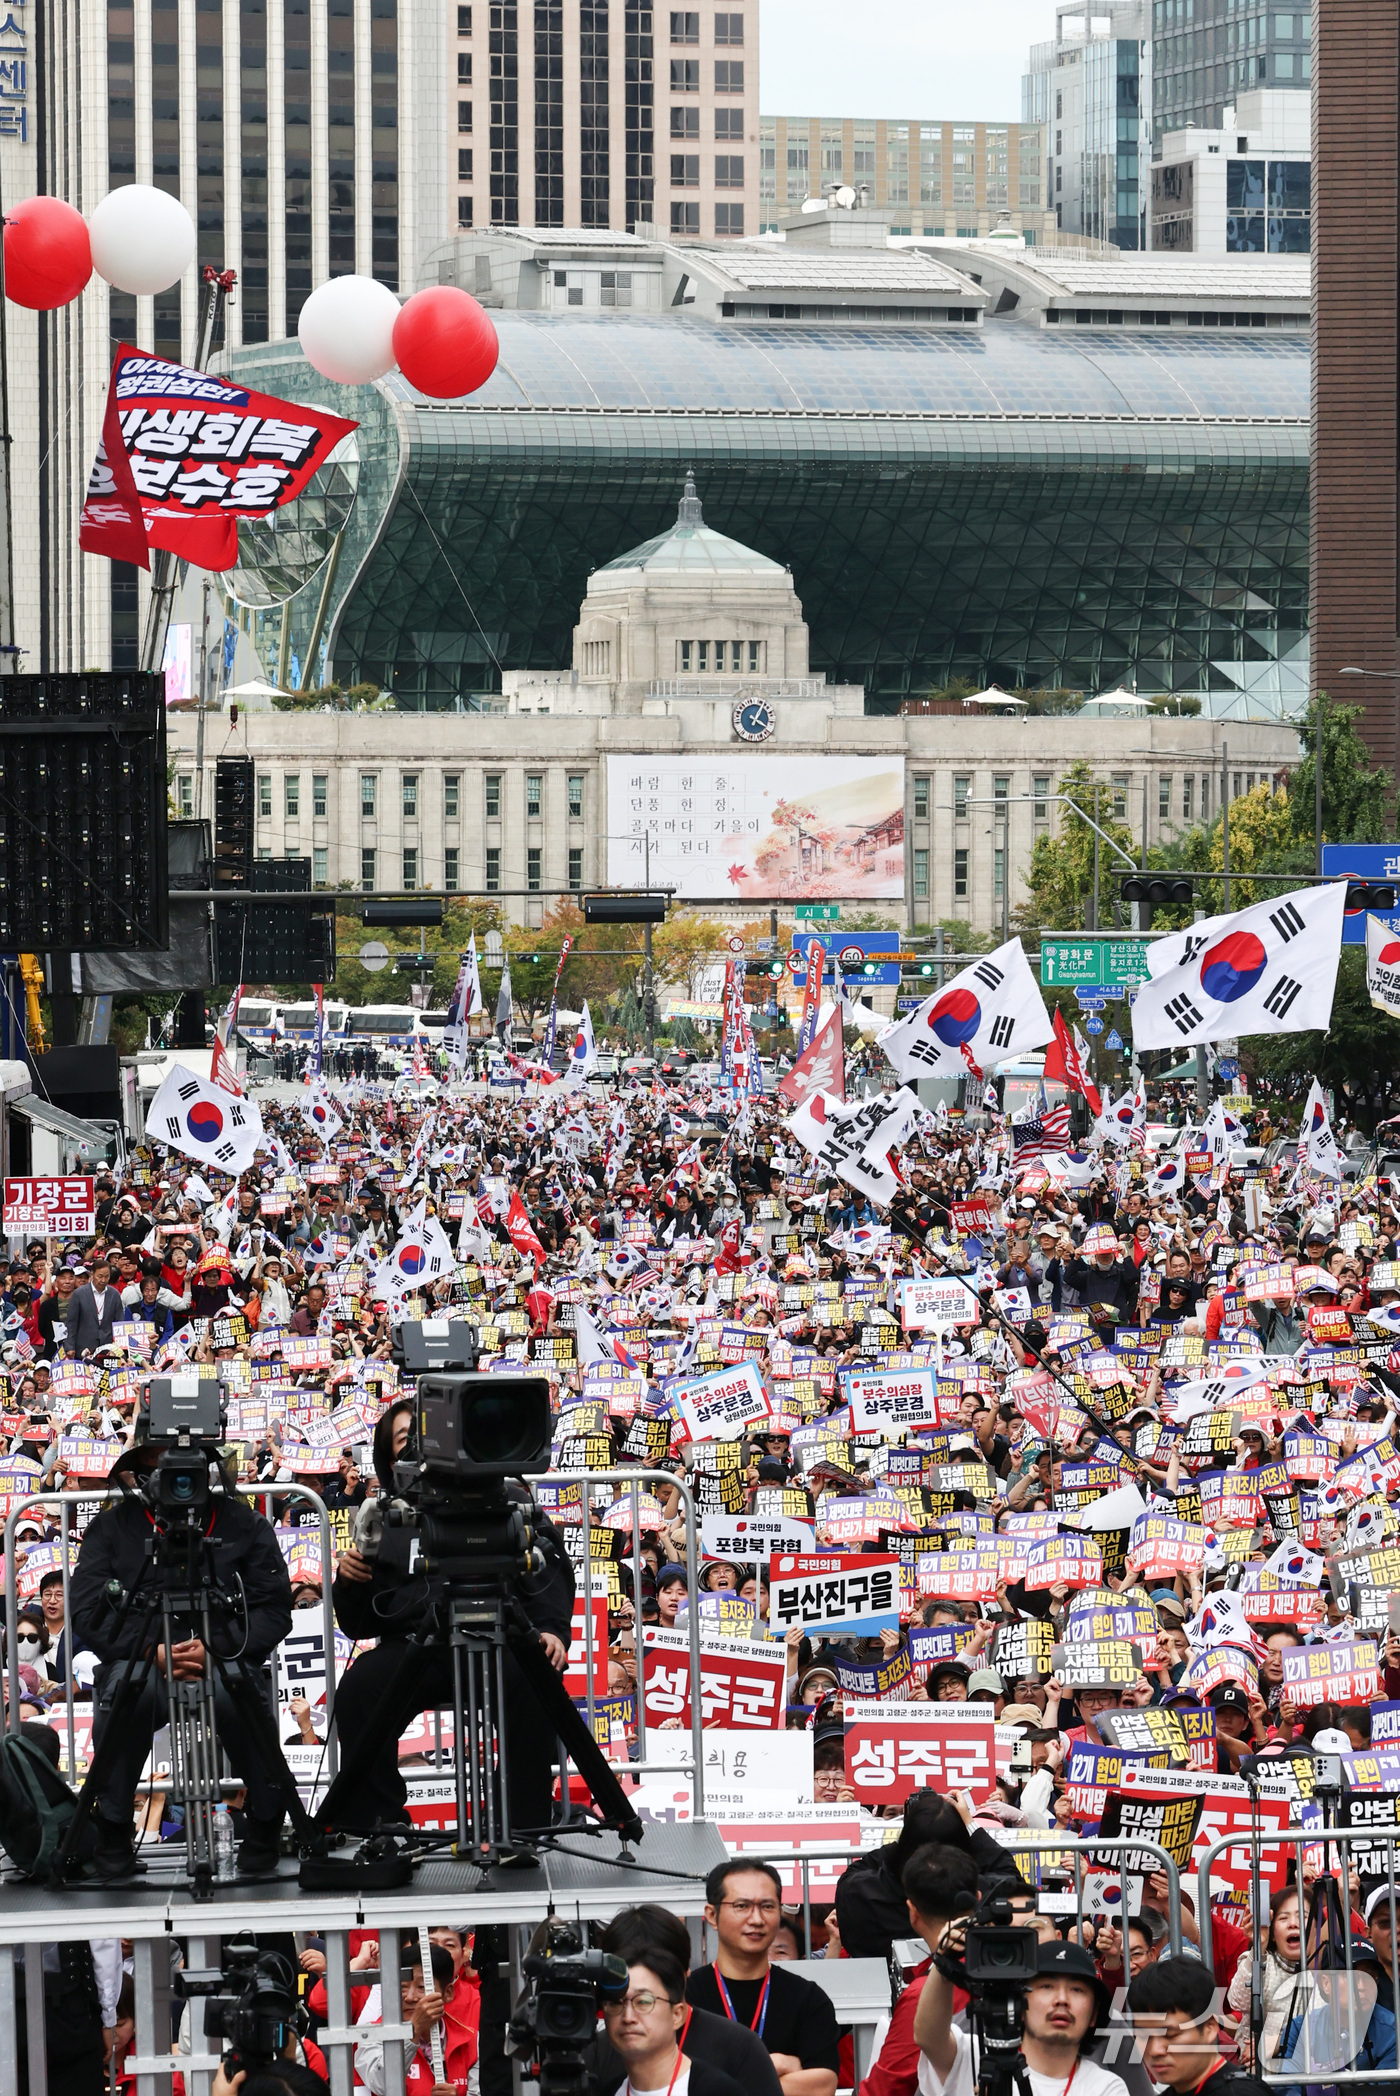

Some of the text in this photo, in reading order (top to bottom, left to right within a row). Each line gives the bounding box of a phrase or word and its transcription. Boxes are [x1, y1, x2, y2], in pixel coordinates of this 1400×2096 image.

[0, 0, 27, 142] 스센터
[208, 291, 217, 320] KATO
[129, 454, 290, 507] 보수호
[631, 776, 735, 790] 바람 한 줄,
[631, 798, 735, 812] 단풍 한 장,
[631, 819, 759, 833] 골목마다 가을이
[631, 840, 710, 854] 시가 된다
[805, 909, 831, 917] 시청
[1059, 949, 1094, 960] 광화문
[1059, 961, 1087, 970] 光化門
[1058, 972, 1096, 980] Gwanghwamun
[10, 1181, 88, 1209] 기장군
[5, 1205, 46, 1221] 기장군
[5, 1224, 46, 1232] 당원협의회
[915, 1289, 965, 1301] 보수의심장
[915, 1300, 966, 1314] 상주문경
[937, 1311, 971, 1320] 당원협의회
[1312, 1310, 1346, 1325] 이재명
[534, 1338, 573, 1350] 민생파탄
[1165, 1336, 1205, 1348] 민생파탄
[534, 1349, 572, 1358] 사법파괴
[584, 1380, 640, 1395] 제멋대로 농지조사
[689, 1385, 709, 1396] 국민의힘
[692, 1379, 748, 1409] 보수의심장
[863, 1383, 922, 1400] 보수의심장
[697, 1391, 754, 1422] 상주문경
[864, 1396, 924, 1414] 상주문경
[724, 1403, 763, 1423] 당원협의회
[891, 1410, 932, 1422] 당원협의회
[1190, 1412, 1233, 1428] 민생파탄
[632, 1418, 668, 1433] 안보참사
[748, 1420, 768, 1431] OUT
[1187, 1426, 1232, 1439] 사법파괴
[564, 1438, 610, 1452] 민생파탄
[628, 1432, 667, 1446] 종북외교
[692, 1441, 742, 1459] 민생파탄
[561, 1452, 610, 1466] 사법파괴
[692, 1456, 741, 1471] 사법파괴
[889, 1454, 920, 1470] 제멋대로
[939, 1464, 987, 1478] 민생파탄
[700, 1471, 738, 1491] 민생파탄
[699, 1487, 741, 1503] 사법파괴
[757, 1489, 807, 1504] 민생파탄
[972, 1488, 996, 1498] OUT
[828, 1501, 900, 1520] 제멋대로 농지조사
[749, 1523, 781, 1532] 국민의힘
[1147, 1519, 1165, 1538] 혐의
[1167, 1520, 1183, 1540] 5개
[1185, 1524, 1205, 1545] 재판
[716, 1538, 801, 1554] 포항북 당협
[1028, 1537, 1100, 1565] 12개 혐의 5개 재판
[1157, 1540, 1178, 1560] 재판
[798, 1559, 841, 1571] 국민의힘
[919, 1551, 999, 1572] 12개 혐의 5개 재판
[1027, 1560, 1100, 1587] 이재명 재판 재개
[919, 1571, 997, 1594] 이재명 재판 재개
[778, 1571, 892, 1624] 부산진구을
[719, 1599, 755, 1619] 농지조사
[1072, 1609, 1155, 1640] 12개 혐의 5개 재판
[657, 1635, 683, 1645] 국민의힘
[752, 1648, 785, 1658] 당원협의회
[1064, 1642, 1132, 1655] 민생파탄
[1065, 1654, 1133, 1667] 사법파괴
[1285, 1644, 1376, 1681] 12개 혐의 5개 재판
[838, 1652, 911, 1694] 제멋대로 농지조사
[1054, 1668, 1142, 1684] 이재명 OUT
[645, 1665, 776, 1727] 성주군
[1224, 1689, 1235, 1700] FJ
[1288, 1671, 1378, 1706] 이재명 재판 재개
[857, 1708, 992, 1717] 국민의힘 고령군·성주군·칠곡군 당원협의회
[1110, 1710, 1179, 1730] 안보참사
[851, 1739, 989, 1787] 성주군
[1069, 1753, 1122, 1785] 12개 혐의
[1257, 1758, 1315, 1778] 안보참
[1138, 1774, 1167, 1785] 국민의힘
[814, 1809, 860, 1819] 당원협의회
[1119, 1799, 1197, 1827] 민생파탄
